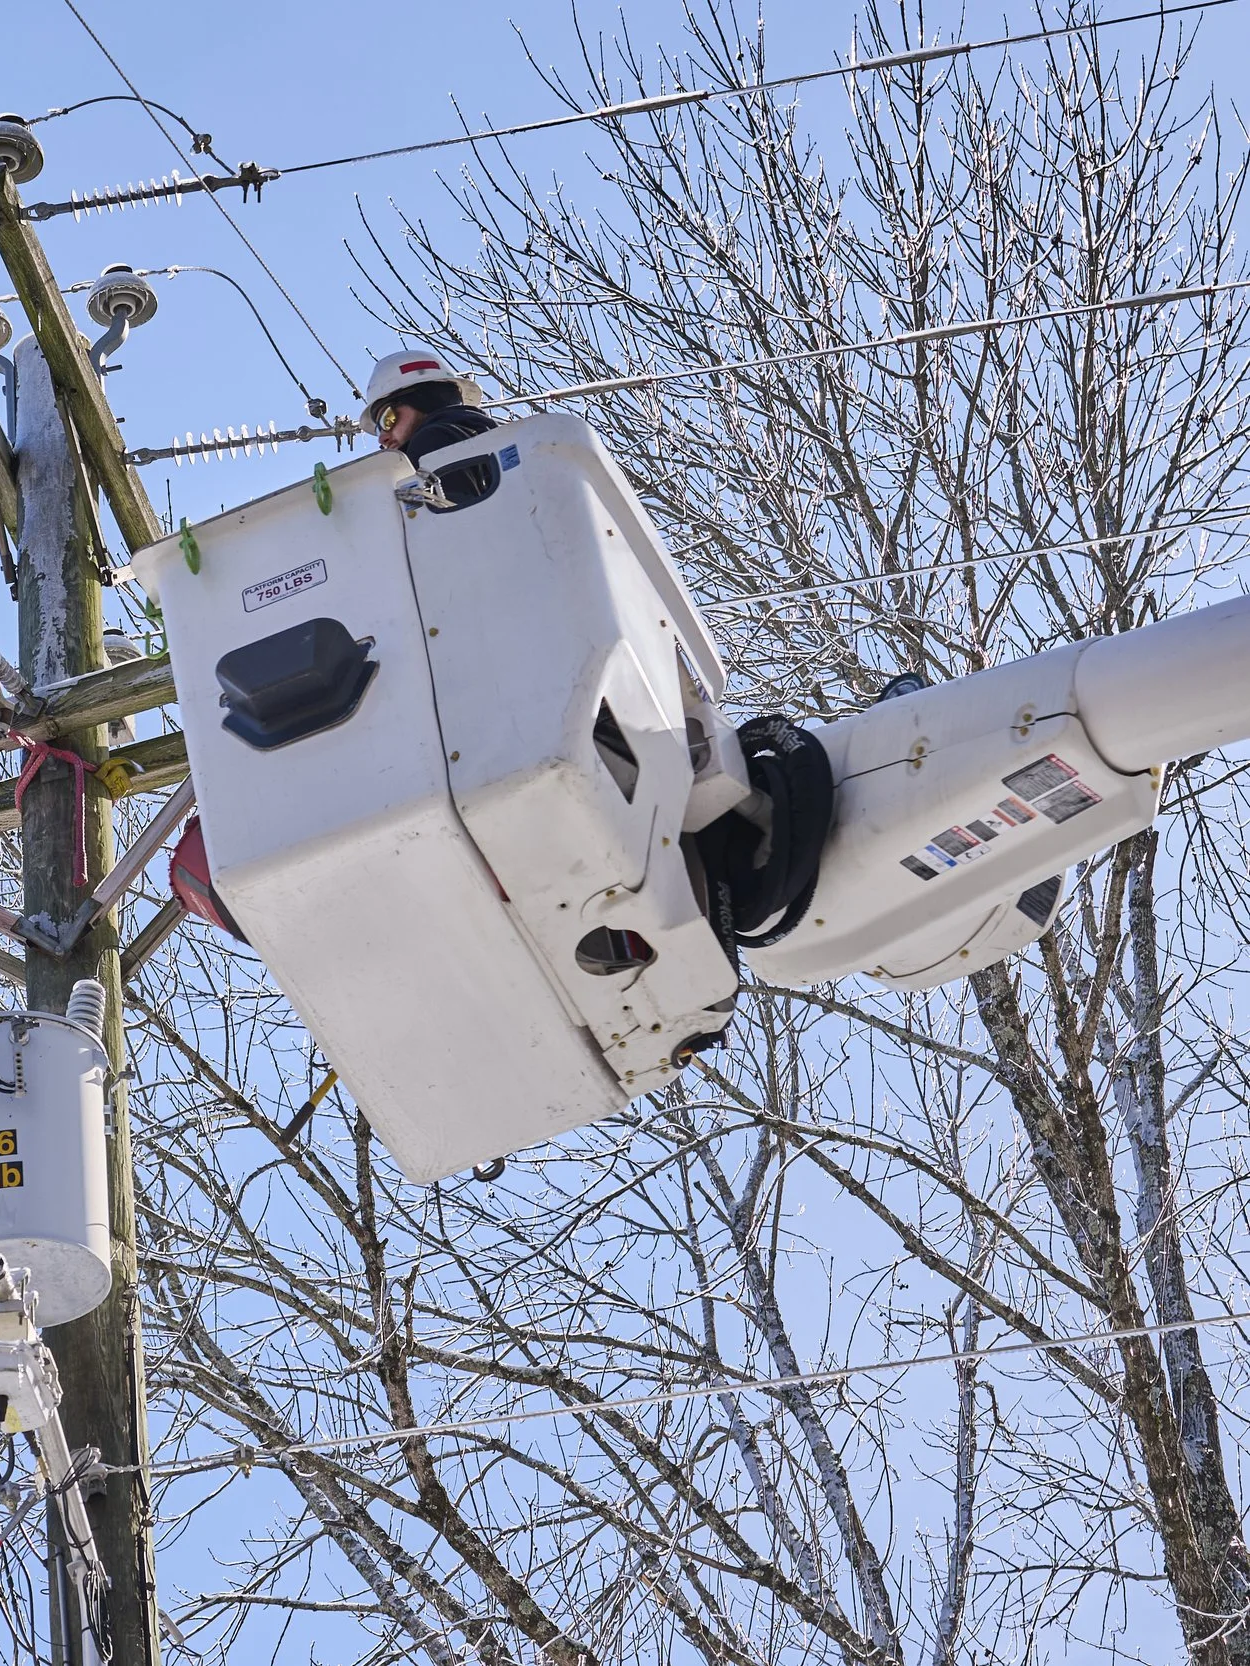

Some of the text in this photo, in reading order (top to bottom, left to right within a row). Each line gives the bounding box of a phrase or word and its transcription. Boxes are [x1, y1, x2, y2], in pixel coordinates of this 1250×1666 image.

[245, 576, 283, 595] PLATFORM
[285, 561, 321, 580] CAPACITY
[257, 586, 281, 602] 750
[284, 573, 313, 591] LBS
